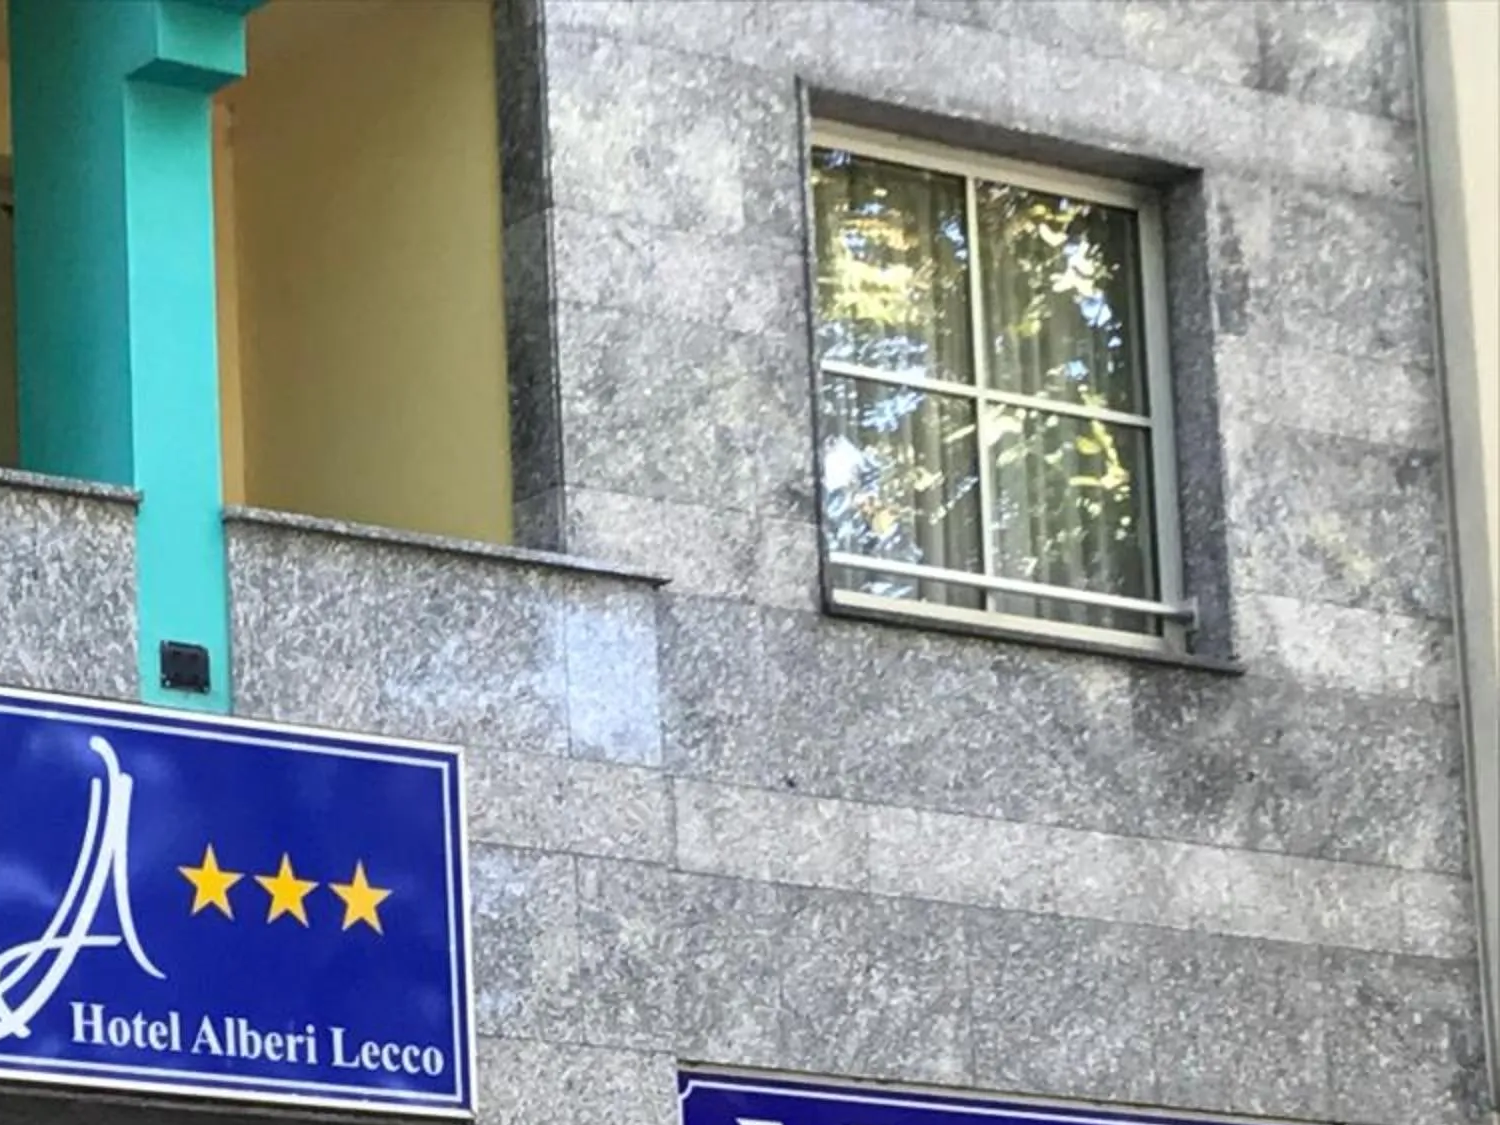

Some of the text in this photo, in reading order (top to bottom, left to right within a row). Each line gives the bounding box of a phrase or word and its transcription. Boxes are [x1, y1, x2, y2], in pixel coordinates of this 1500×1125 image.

[70, 1001, 444, 1076] Hotel Alberi Lecco
